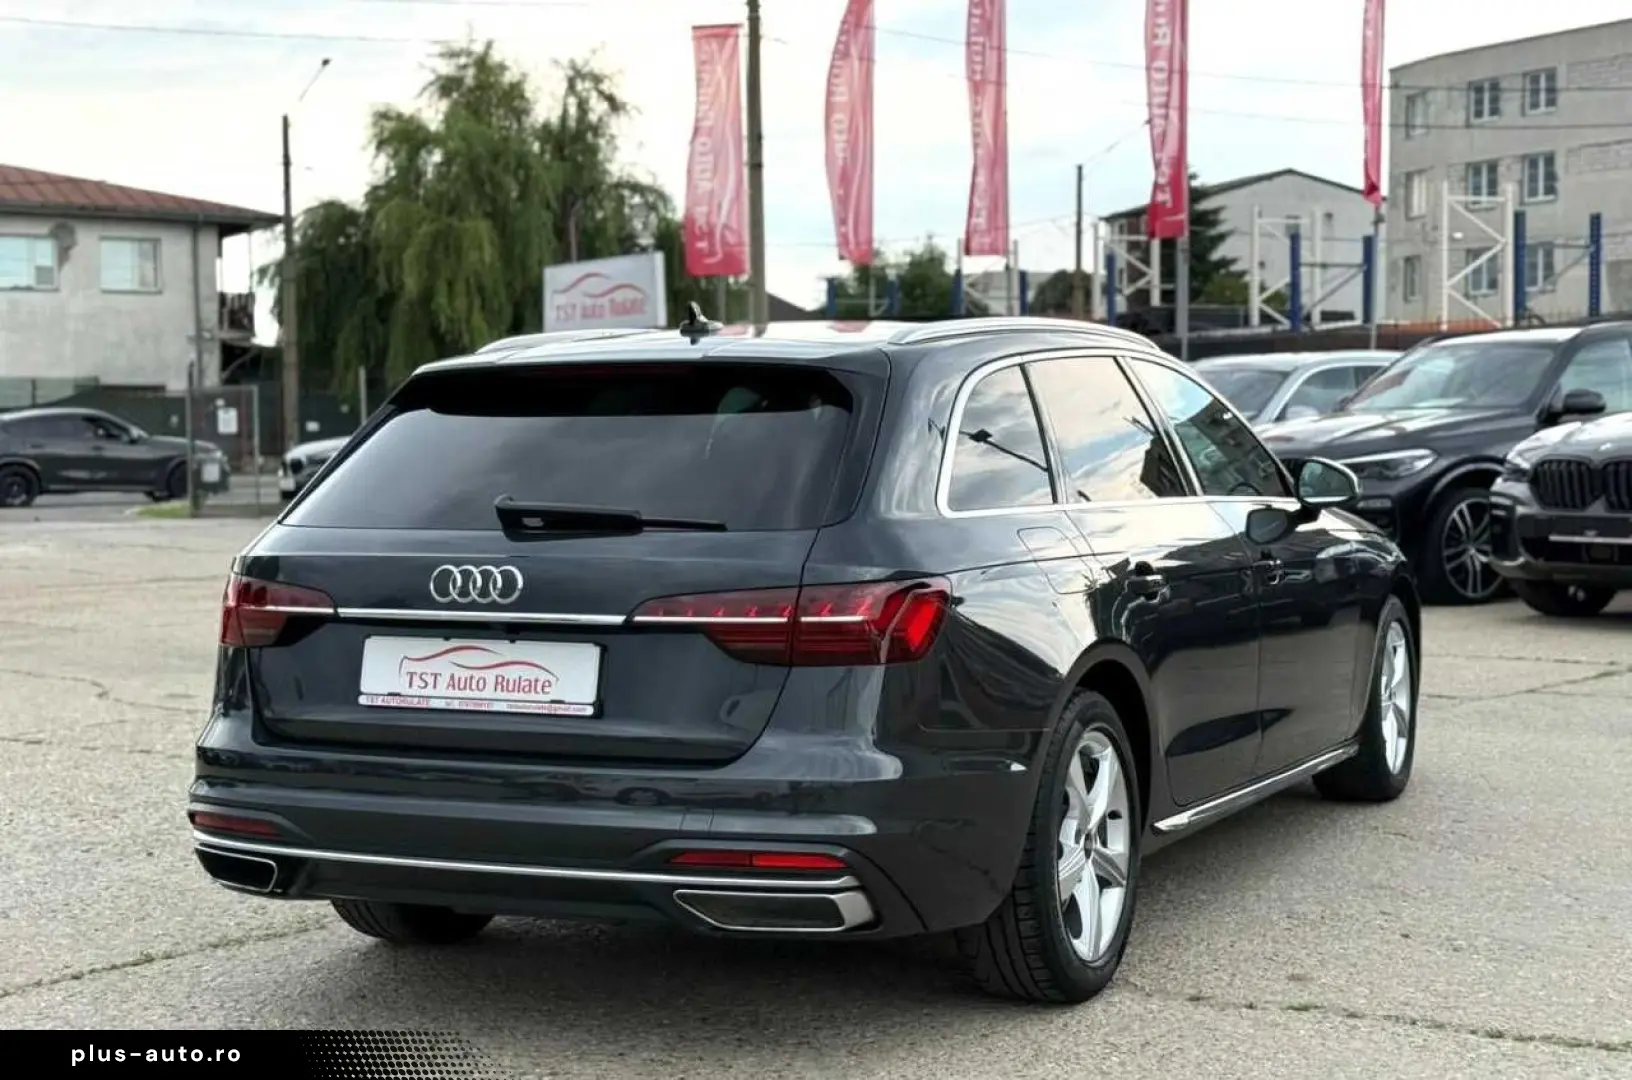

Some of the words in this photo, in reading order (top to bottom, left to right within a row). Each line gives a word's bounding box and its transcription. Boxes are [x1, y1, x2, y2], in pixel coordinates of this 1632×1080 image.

[406, 671, 442, 690] TST
[445, 672, 487, 692] Auto
[494, 674, 553, 696] Rulate
